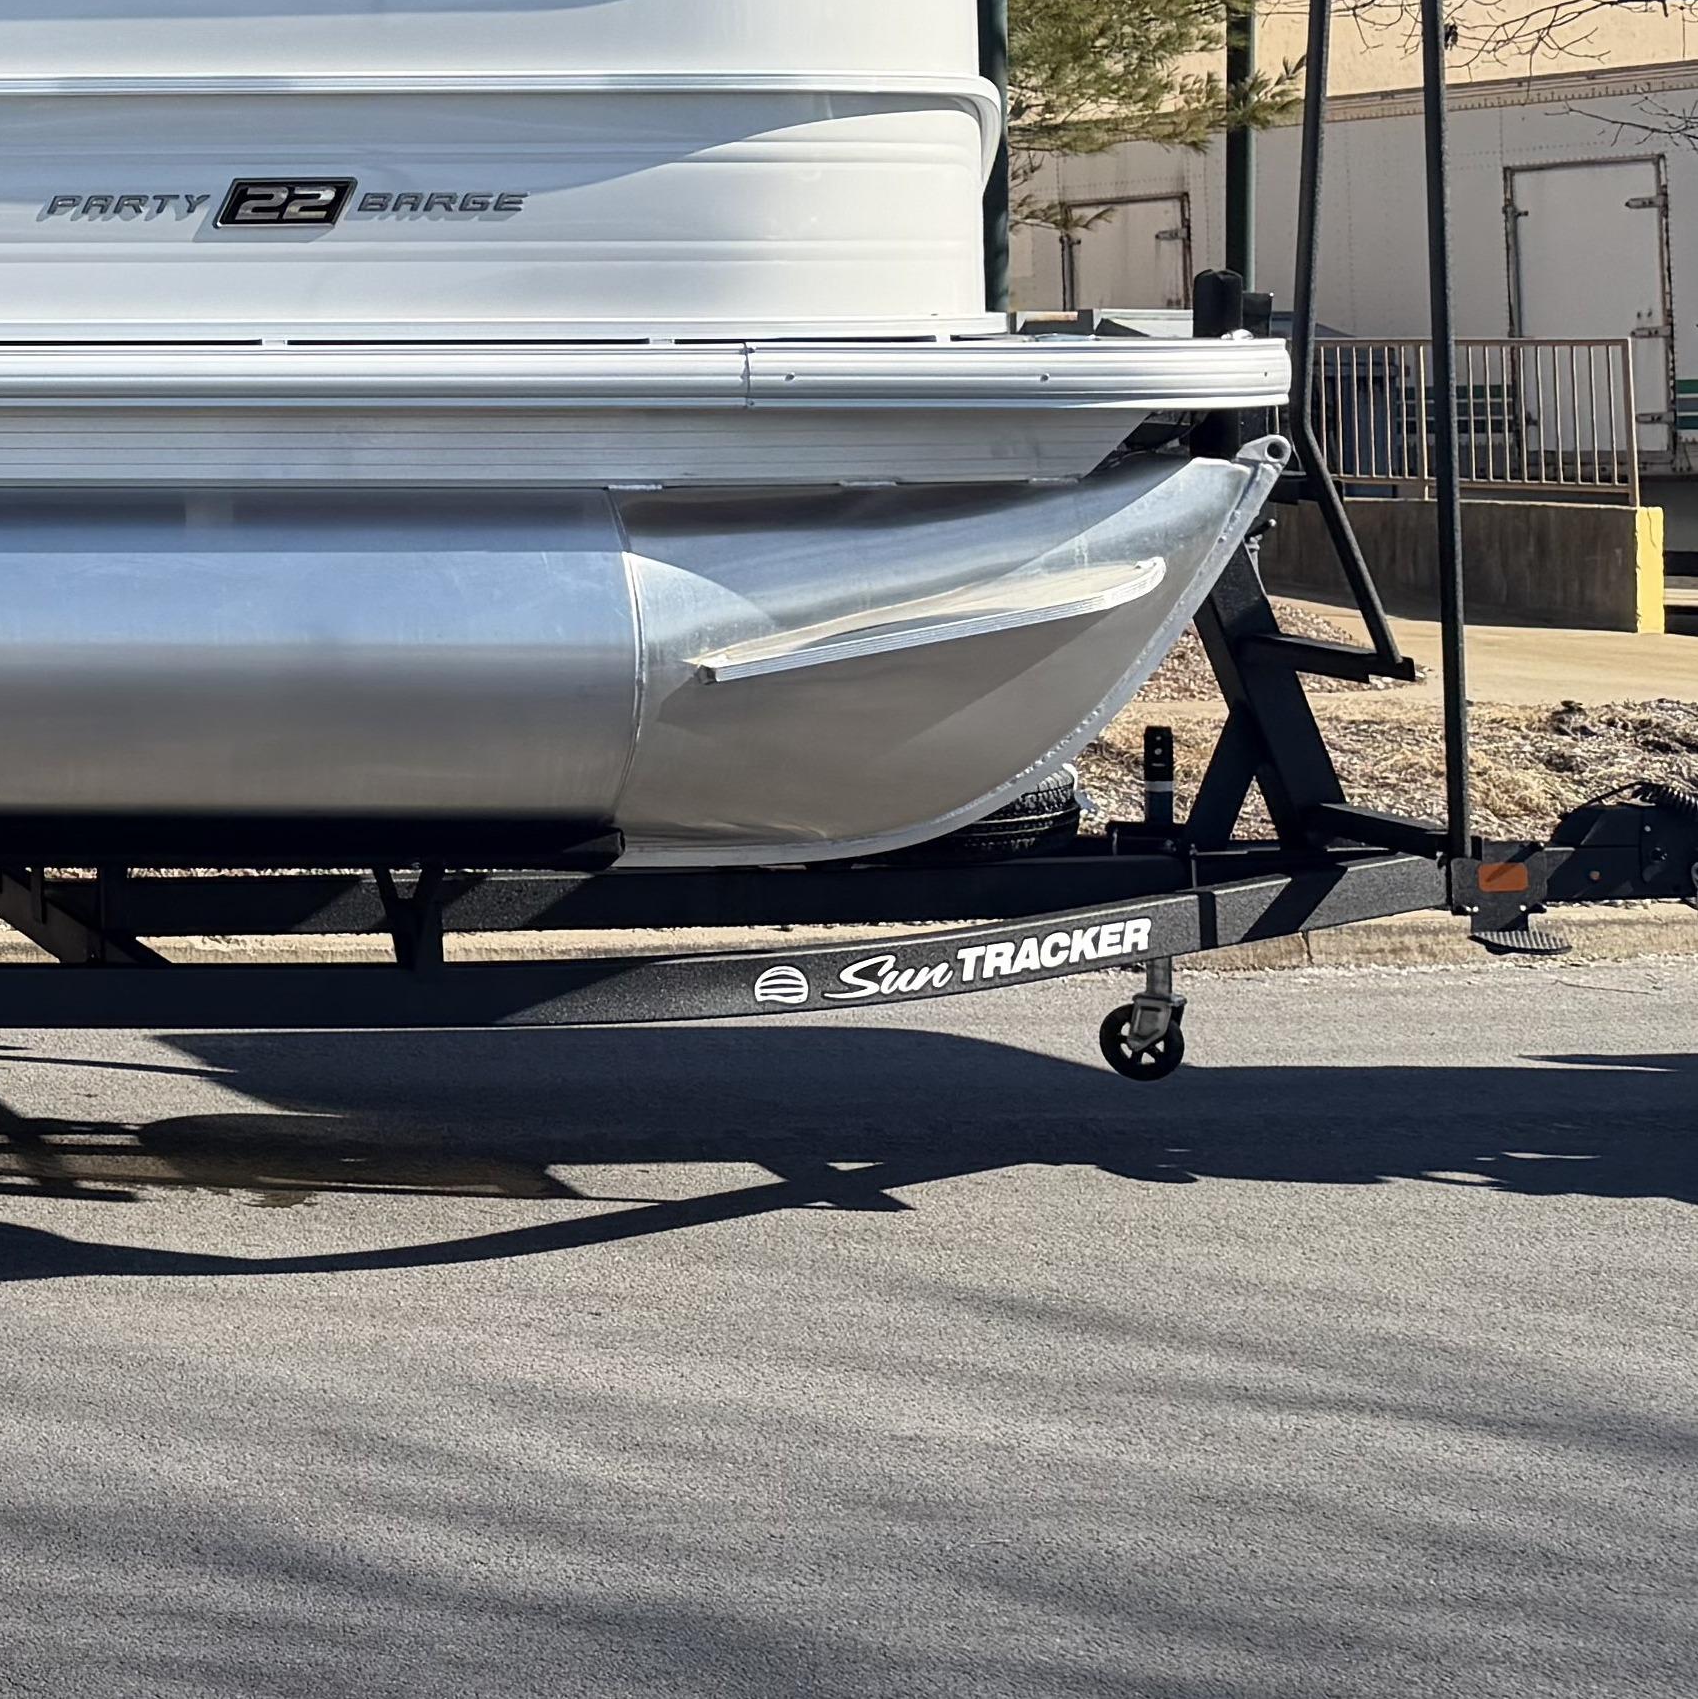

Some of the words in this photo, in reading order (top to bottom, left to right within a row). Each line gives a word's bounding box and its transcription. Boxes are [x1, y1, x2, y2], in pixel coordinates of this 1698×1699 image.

[47, 194, 210, 215] PARTY
[235, 185, 335, 220] 22
[356, 191, 529, 213] BARGE
[822, 955, 954, 1000] Sun
[956, 918, 1152, 982] TRACKER
